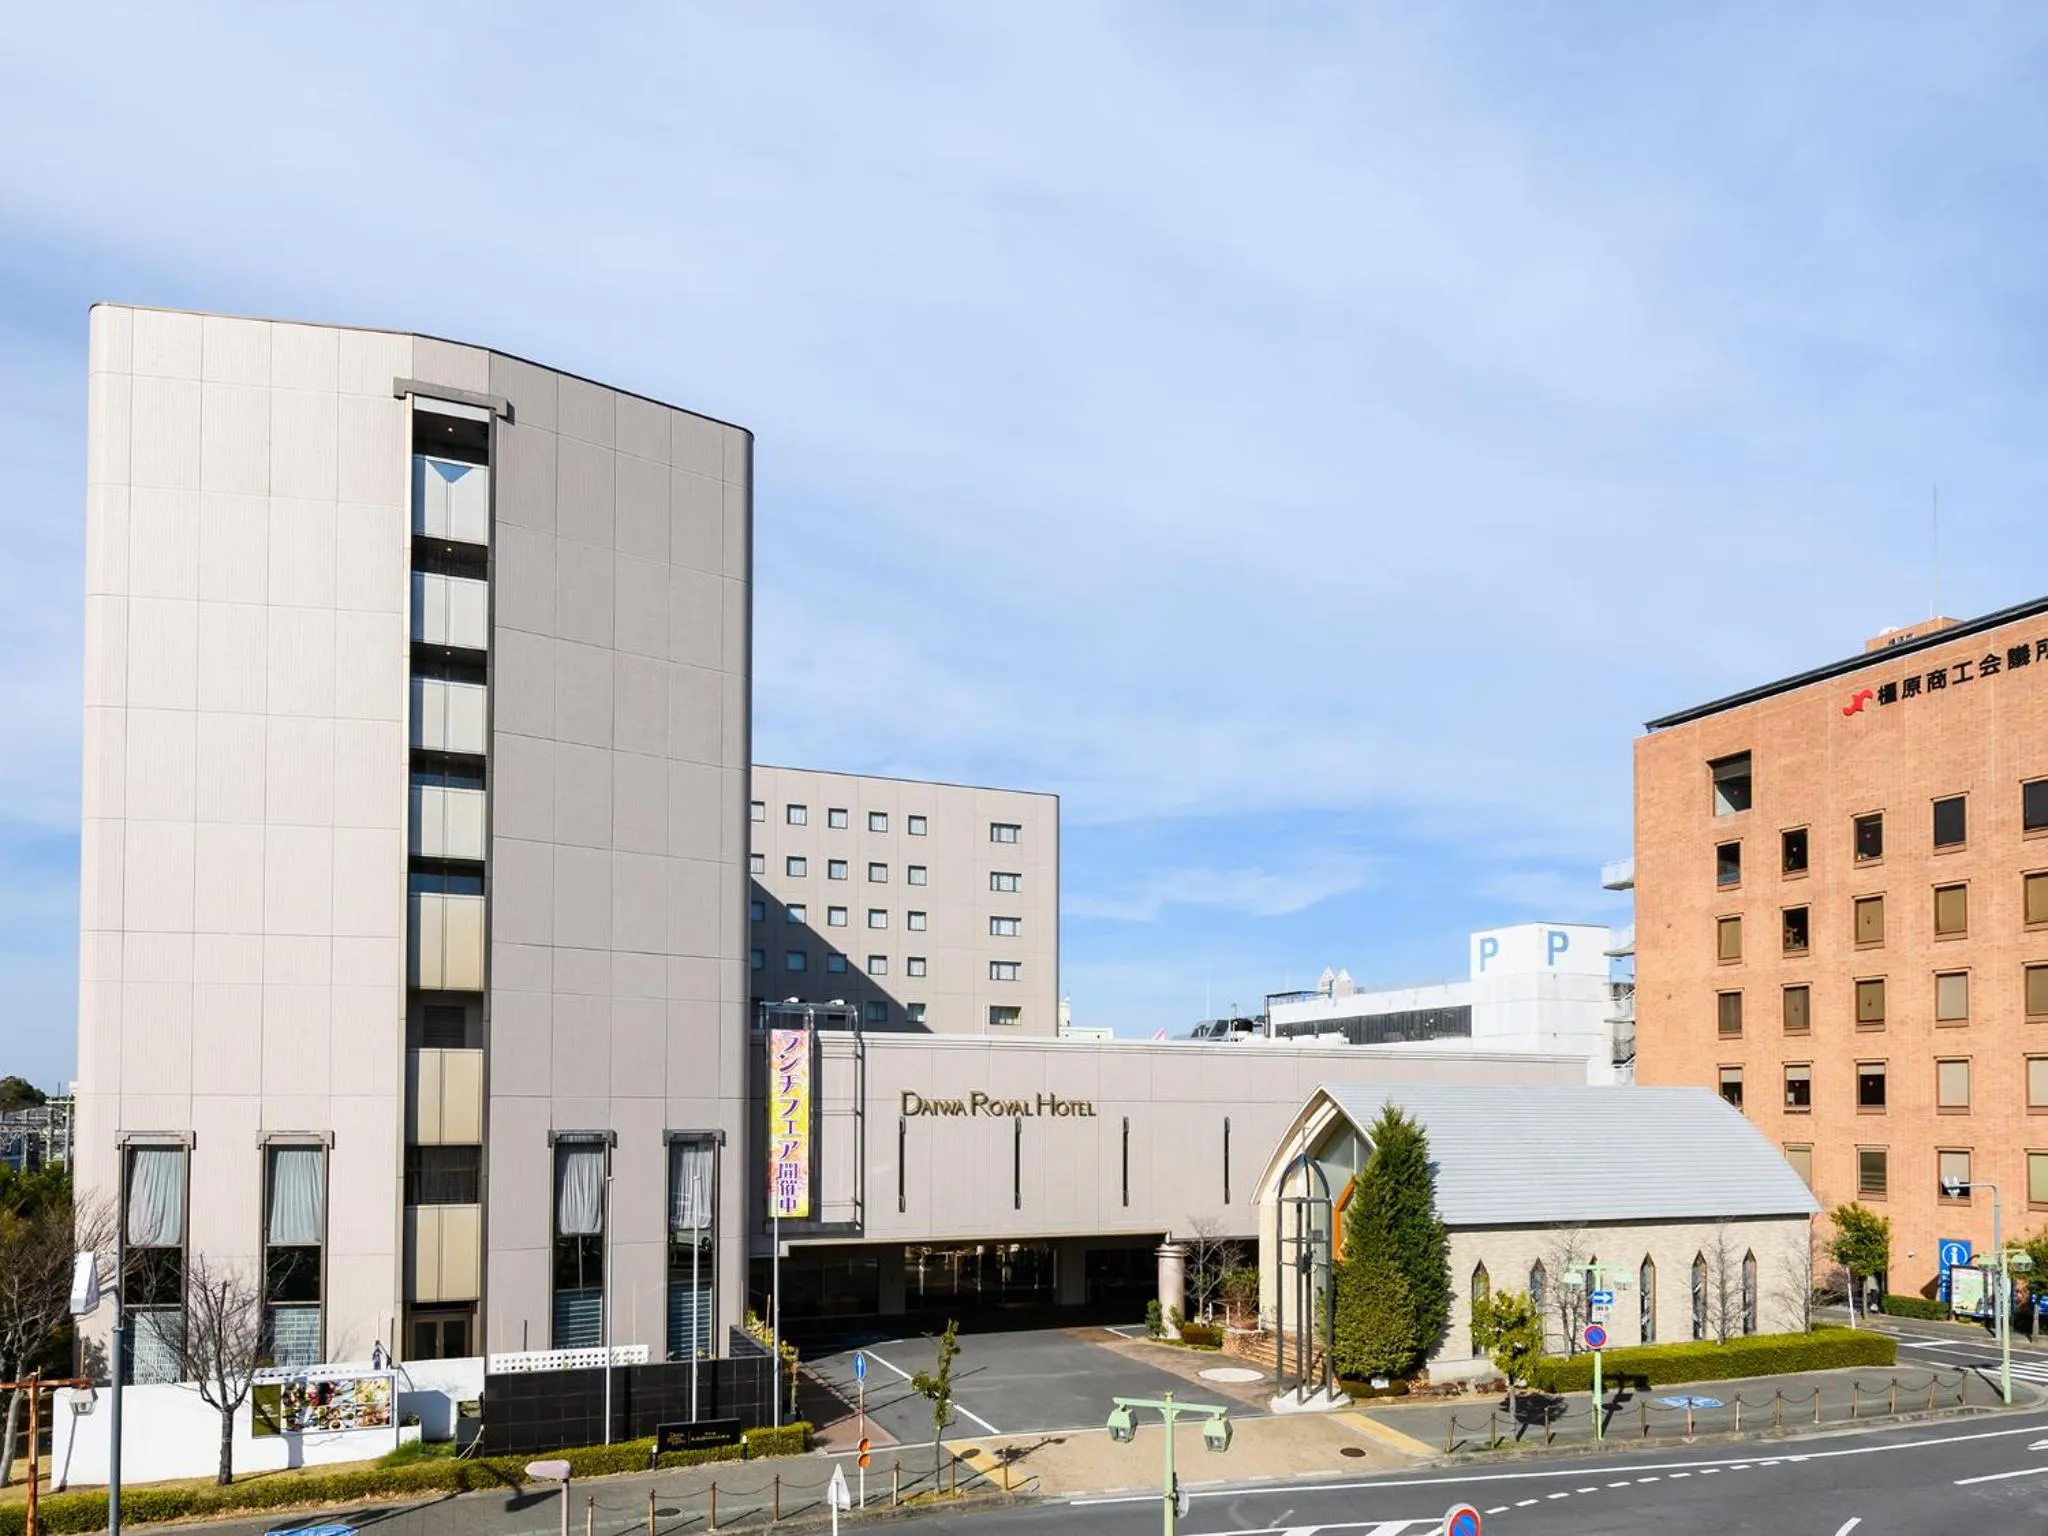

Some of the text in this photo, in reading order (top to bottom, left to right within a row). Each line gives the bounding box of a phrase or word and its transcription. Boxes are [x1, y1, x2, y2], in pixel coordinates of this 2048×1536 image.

[1480, 937, 1498, 972] P
[1547, 930, 1569, 966] P
[970, 1090, 1034, 1117] ROYAL
[1036, 1091, 1097, 1117] HOTEL
